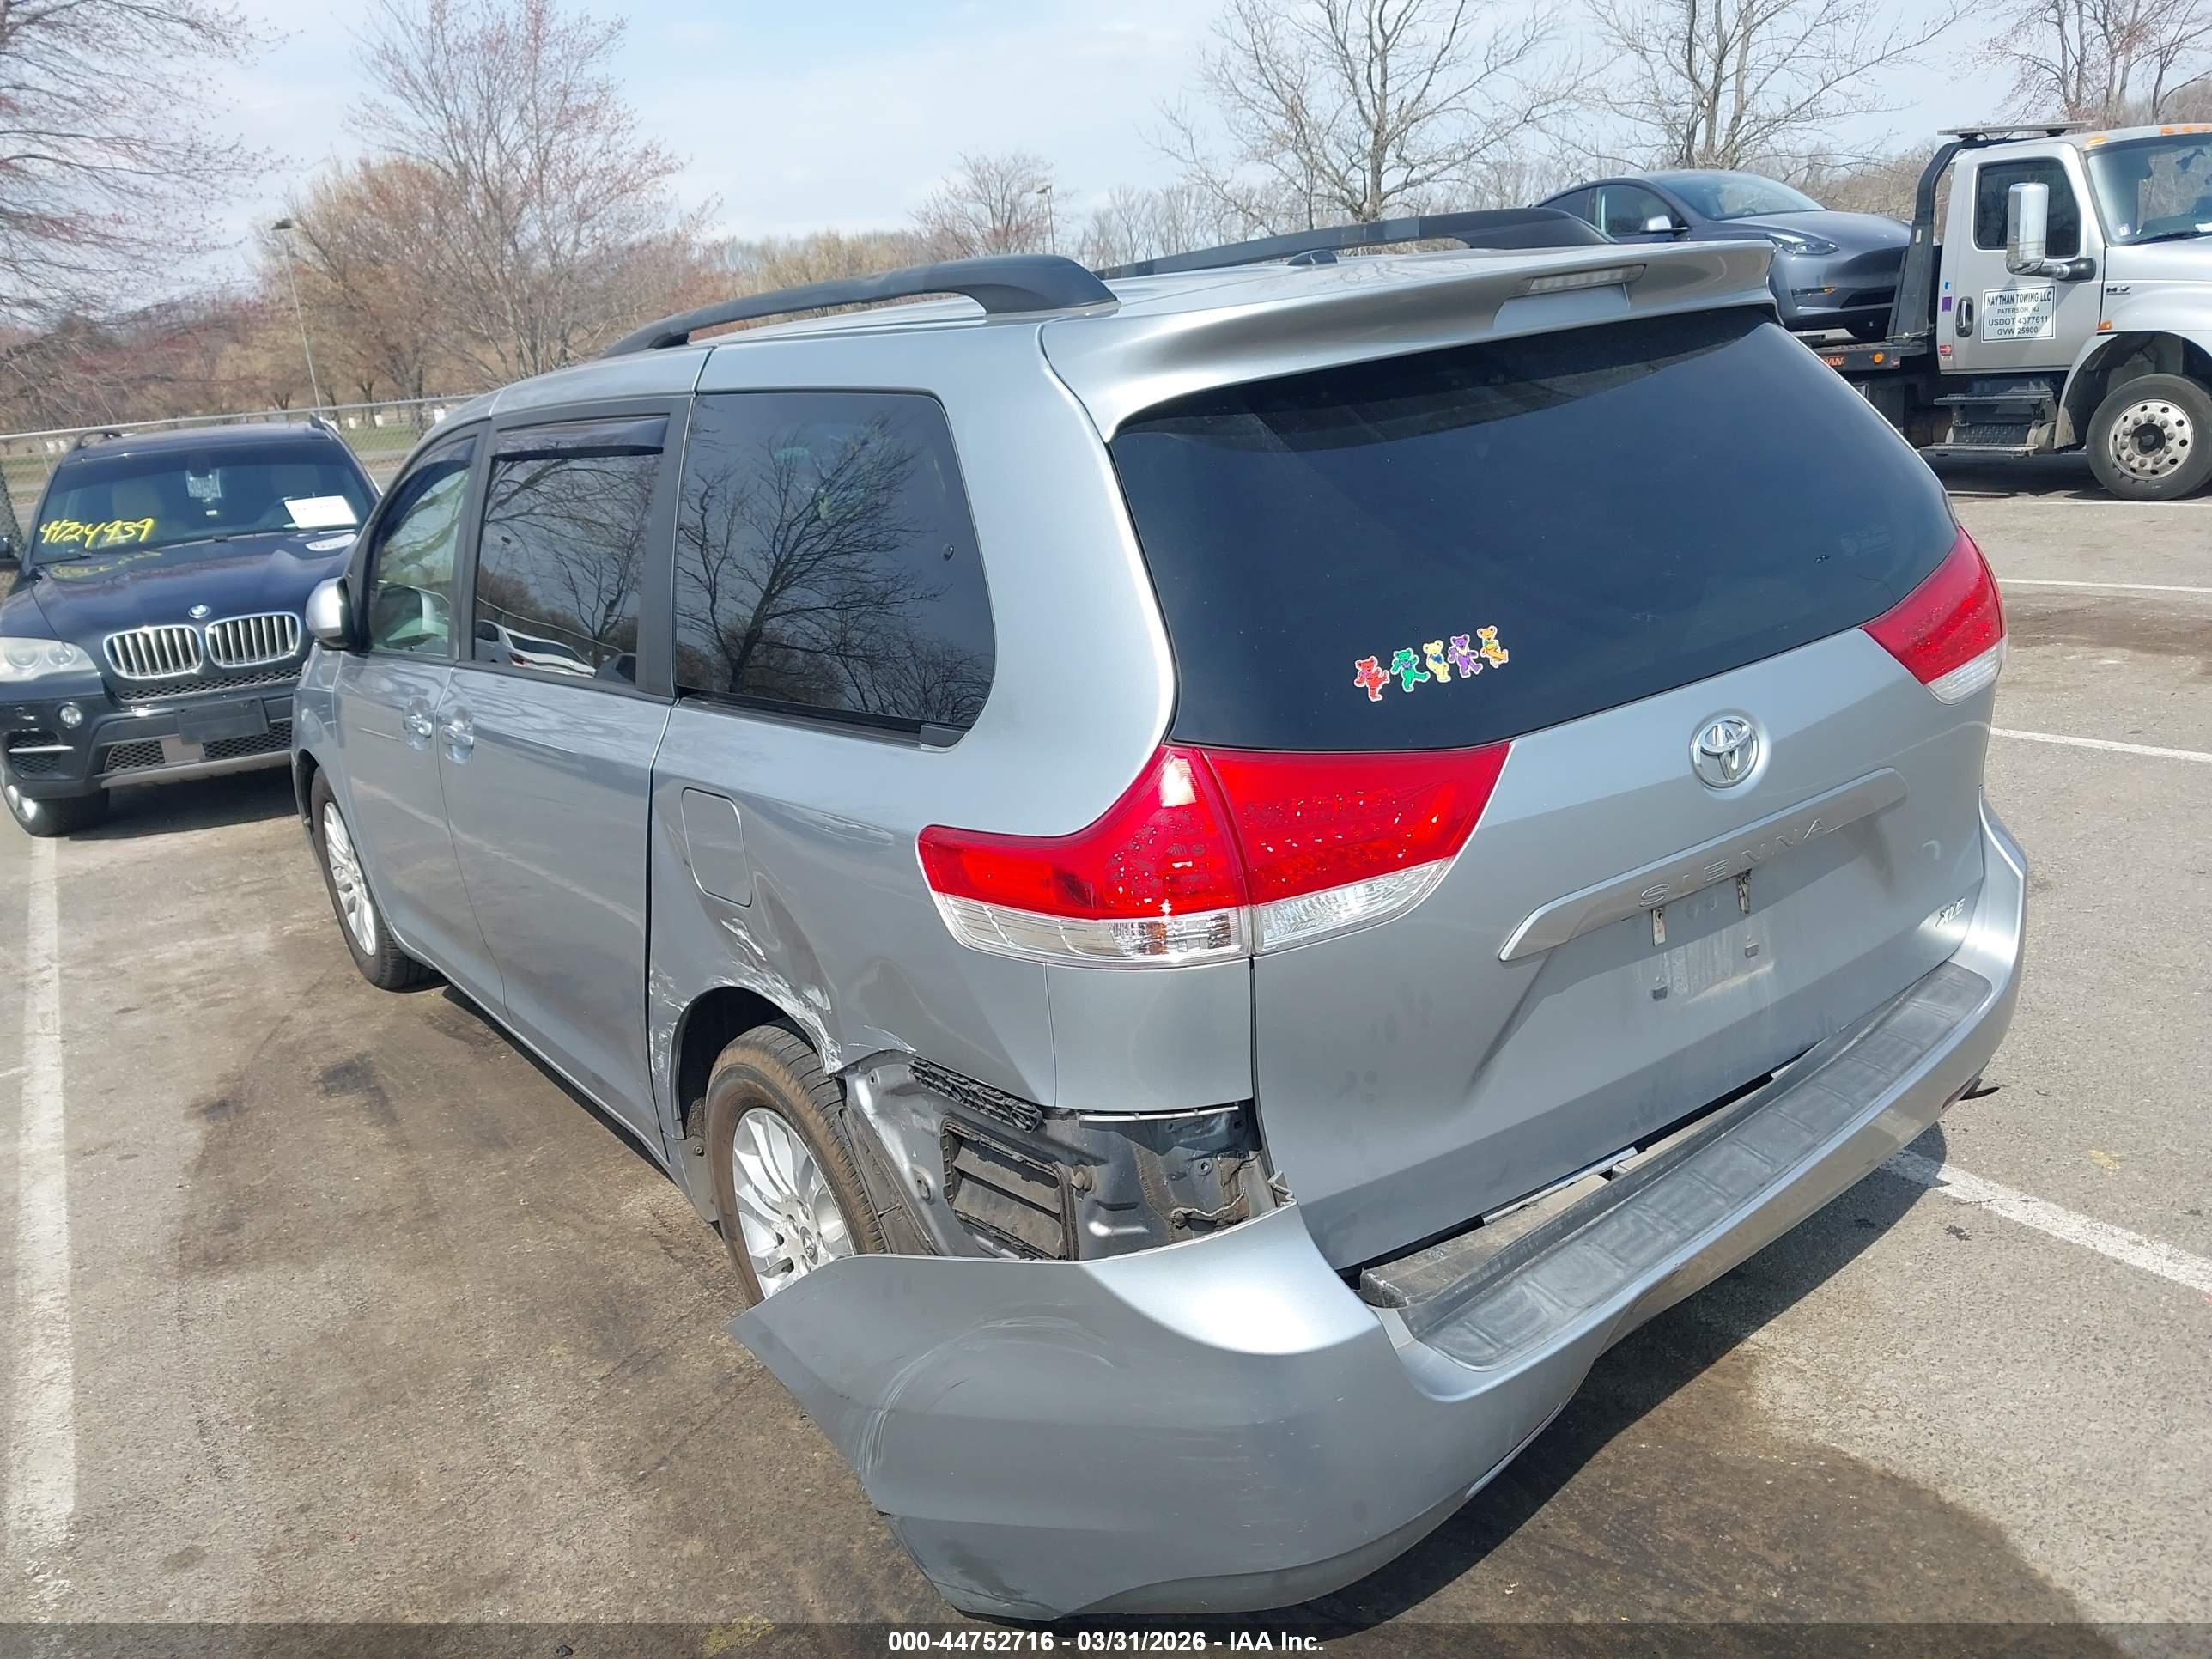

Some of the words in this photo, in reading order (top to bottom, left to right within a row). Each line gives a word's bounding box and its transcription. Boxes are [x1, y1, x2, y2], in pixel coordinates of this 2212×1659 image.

[1987, 294, 2014, 307] NAYTHAN
[2015, 292, 2039, 304] TOWING
[2039, 290, 2051, 302] LLC
[1988, 317, 2015, 326] USDOT
[2018, 315, 2048, 324] 4377611
[2016, 326, 2039, 335] 25900
[1638, 817, 1832, 908] SIENNA
[1936, 897, 1966, 928] XLE
